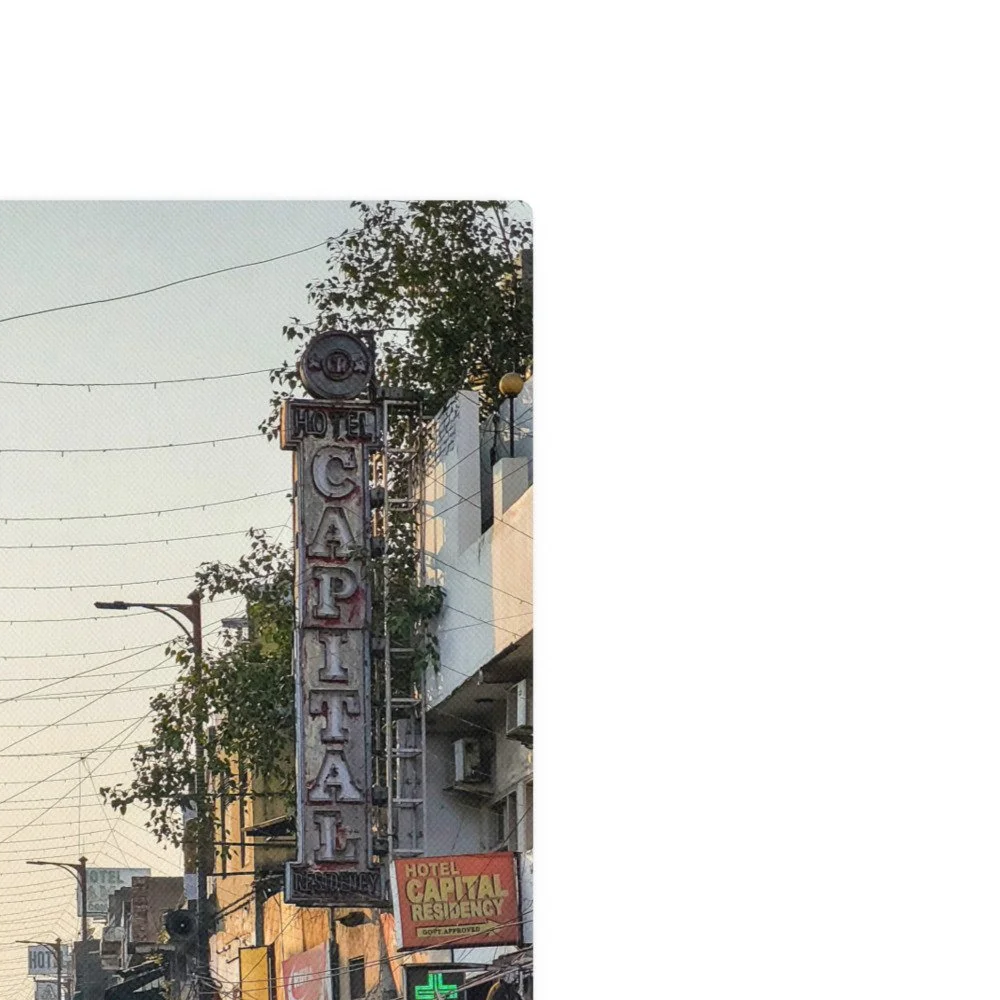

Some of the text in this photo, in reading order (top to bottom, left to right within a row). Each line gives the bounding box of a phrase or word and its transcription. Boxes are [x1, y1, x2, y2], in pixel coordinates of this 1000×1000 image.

[292, 408, 374, 438] HOTEL
[307, 445, 362, 862] CAPITAL
[89, 870, 125, 884] OTEL
[405, 862, 460, 878] HOTEL
[406, 873, 509, 904] CAPITAL
[411, 898, 504, 921] RESIDENCY
